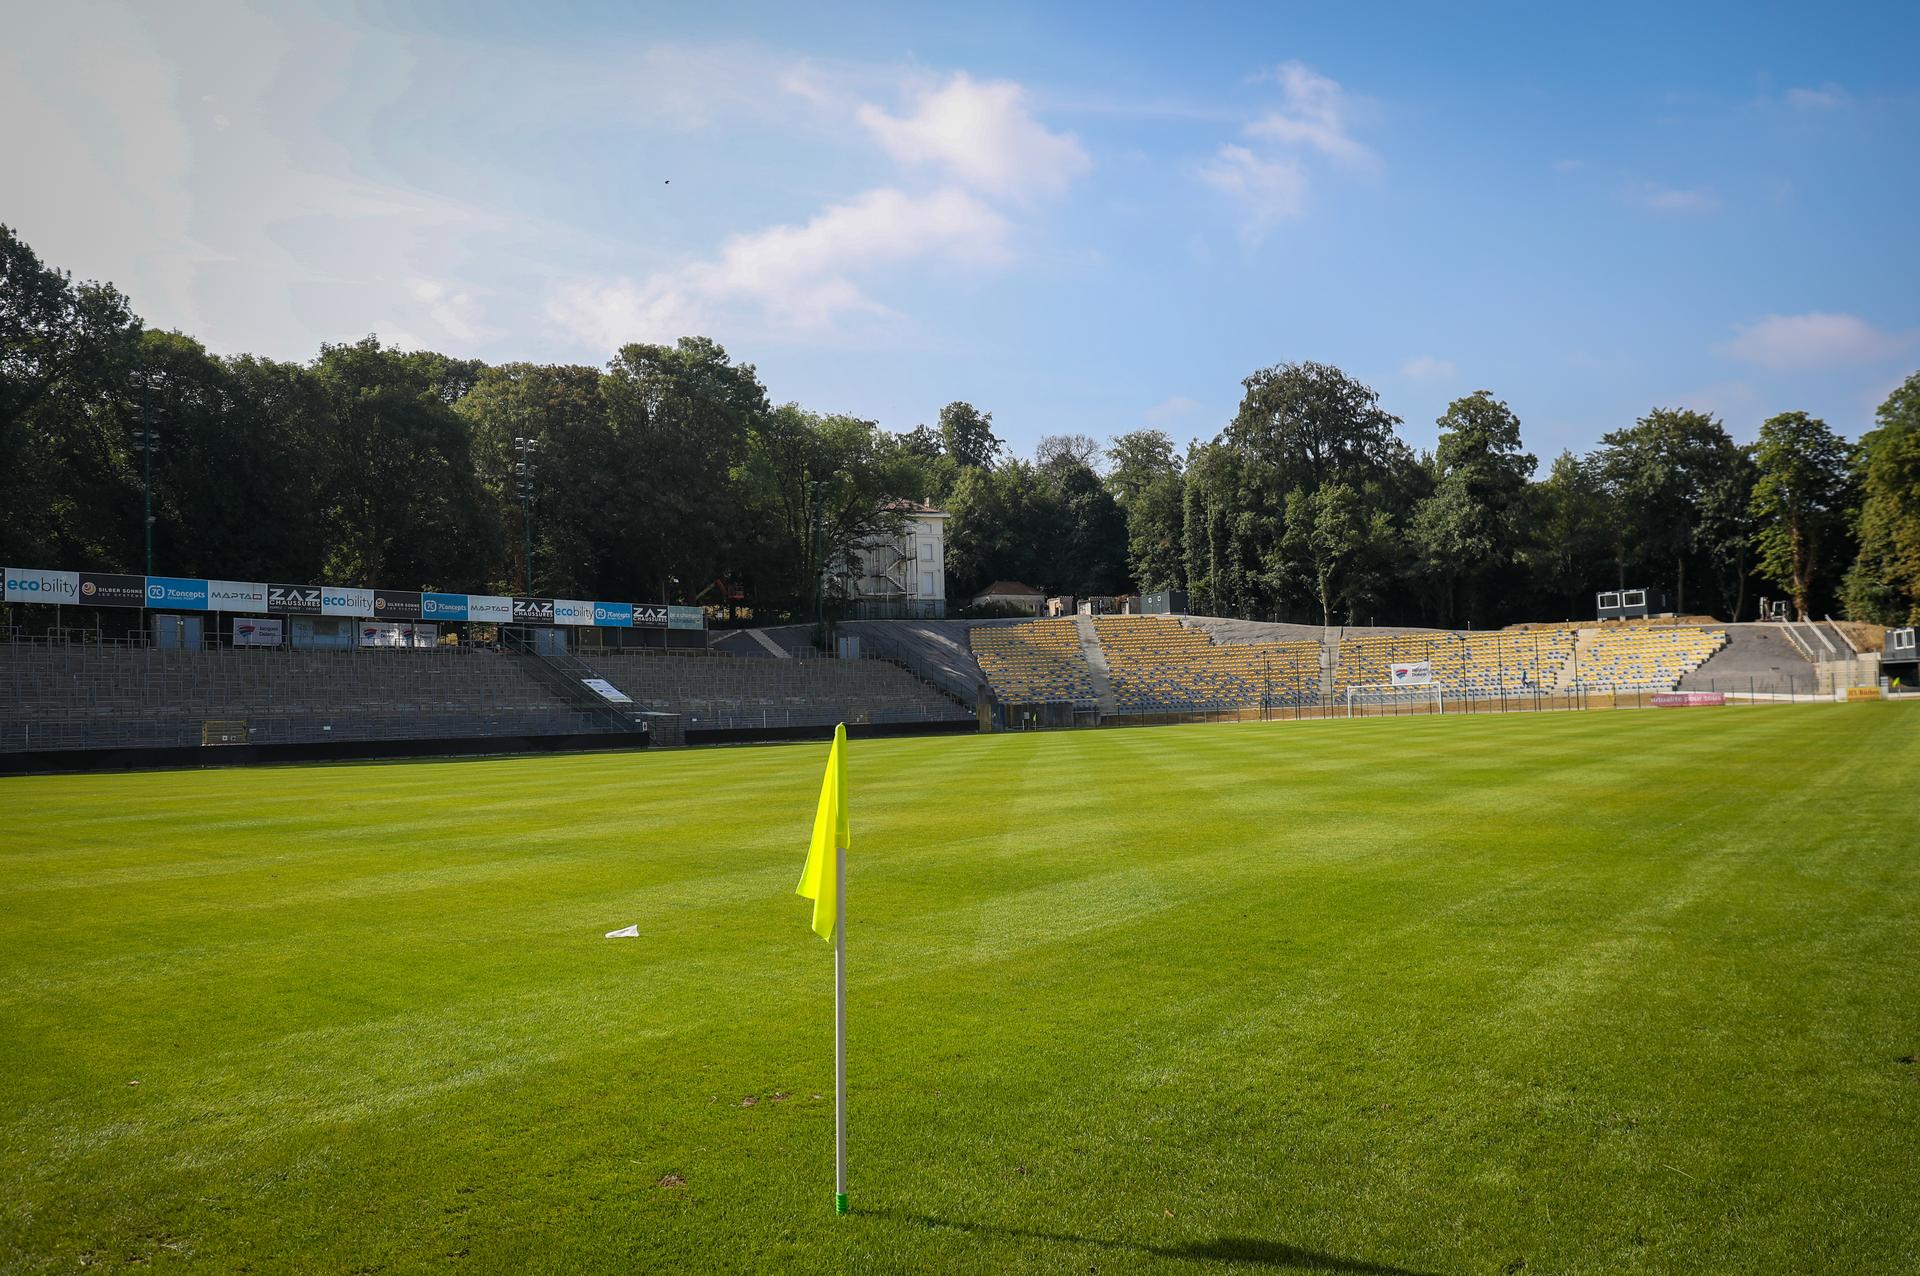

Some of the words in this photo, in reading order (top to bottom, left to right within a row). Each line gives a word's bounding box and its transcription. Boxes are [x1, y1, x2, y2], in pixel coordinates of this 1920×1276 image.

[7, 577, 78, 597] ecobility
[167, 589, 206, 599] 7Concepts
[269, 588, 321, 602] ZAZ
[323, 594, 374, 611] ecobility
[513, 601, 553, 612] ZAZ
[555, 606, 593, 620] ecobility
[633, 607, 667, 617] ZAZ
